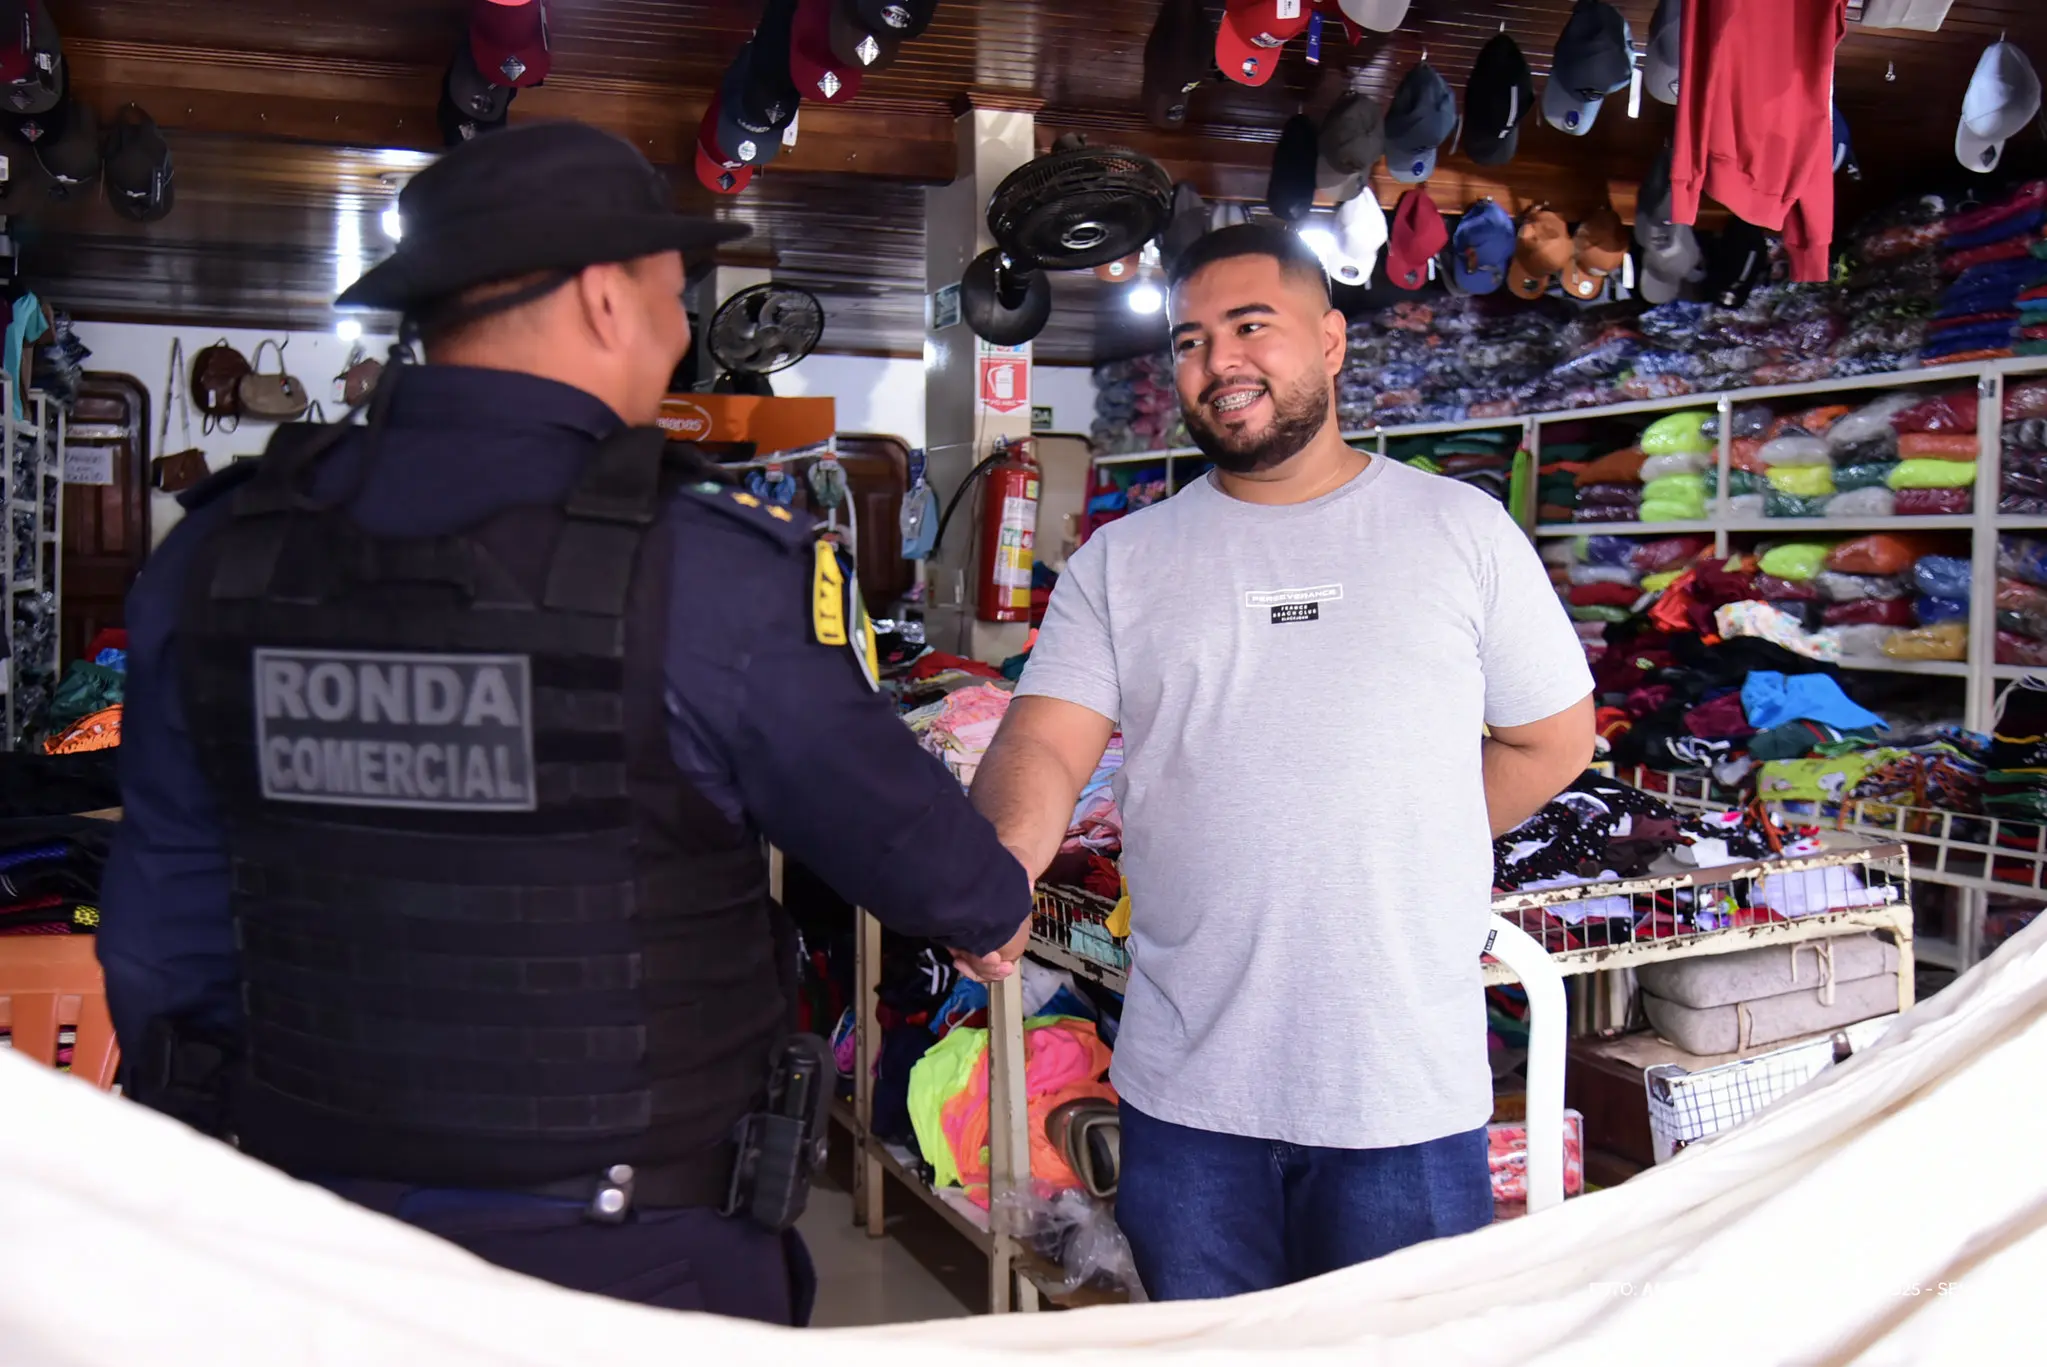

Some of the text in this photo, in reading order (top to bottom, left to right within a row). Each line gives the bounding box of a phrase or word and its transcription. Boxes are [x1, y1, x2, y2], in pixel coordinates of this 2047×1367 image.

[1252, 589, 1336, 602] PERSEVERANCE
[1272, 608, 1317, 618] BEACH CLUB
[265, 661, 520, 726] RONDA
[268, 736, 523, 799] COMERCIAL
